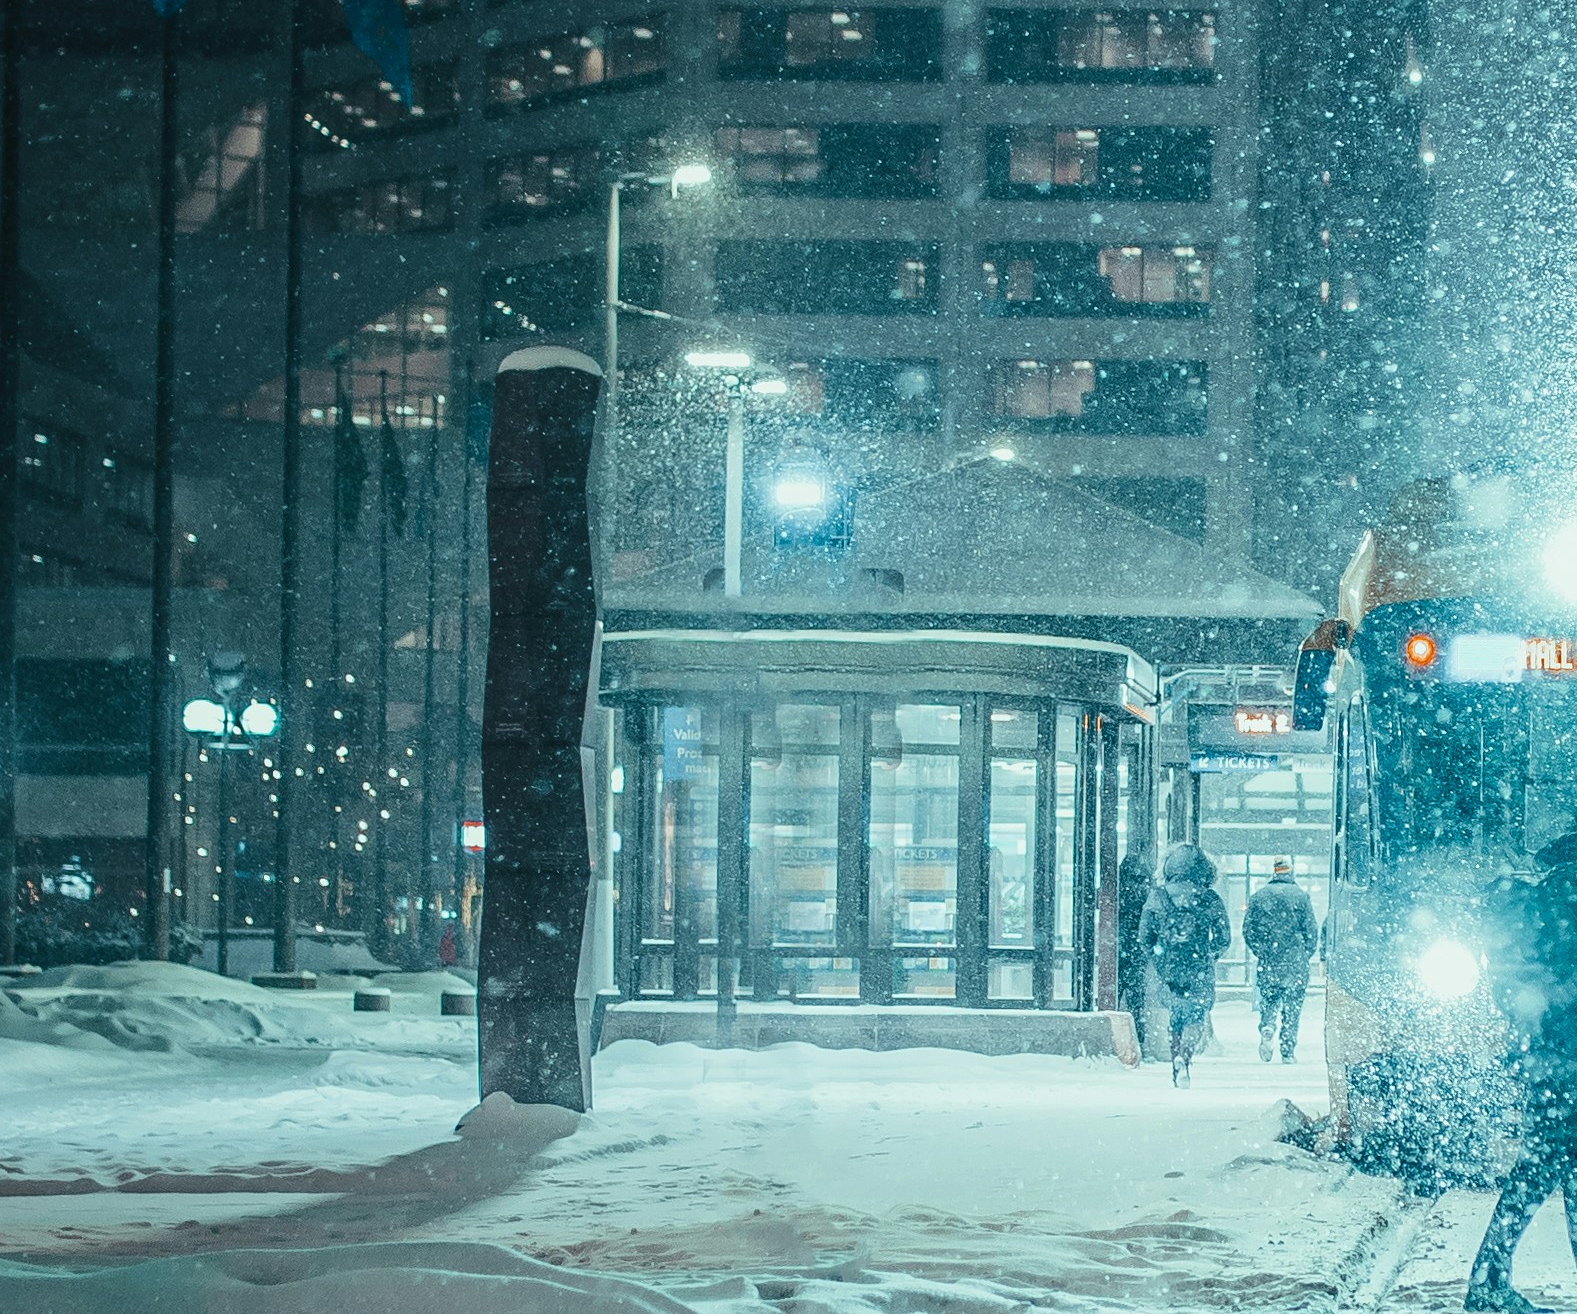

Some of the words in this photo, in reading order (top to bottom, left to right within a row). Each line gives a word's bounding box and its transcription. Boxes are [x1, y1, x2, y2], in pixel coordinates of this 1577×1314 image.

[1524, 639, 1573, 670] MALL
[673, 728, 702, 740] Valid
[1217, 757, 1270, 769] TICKETS
